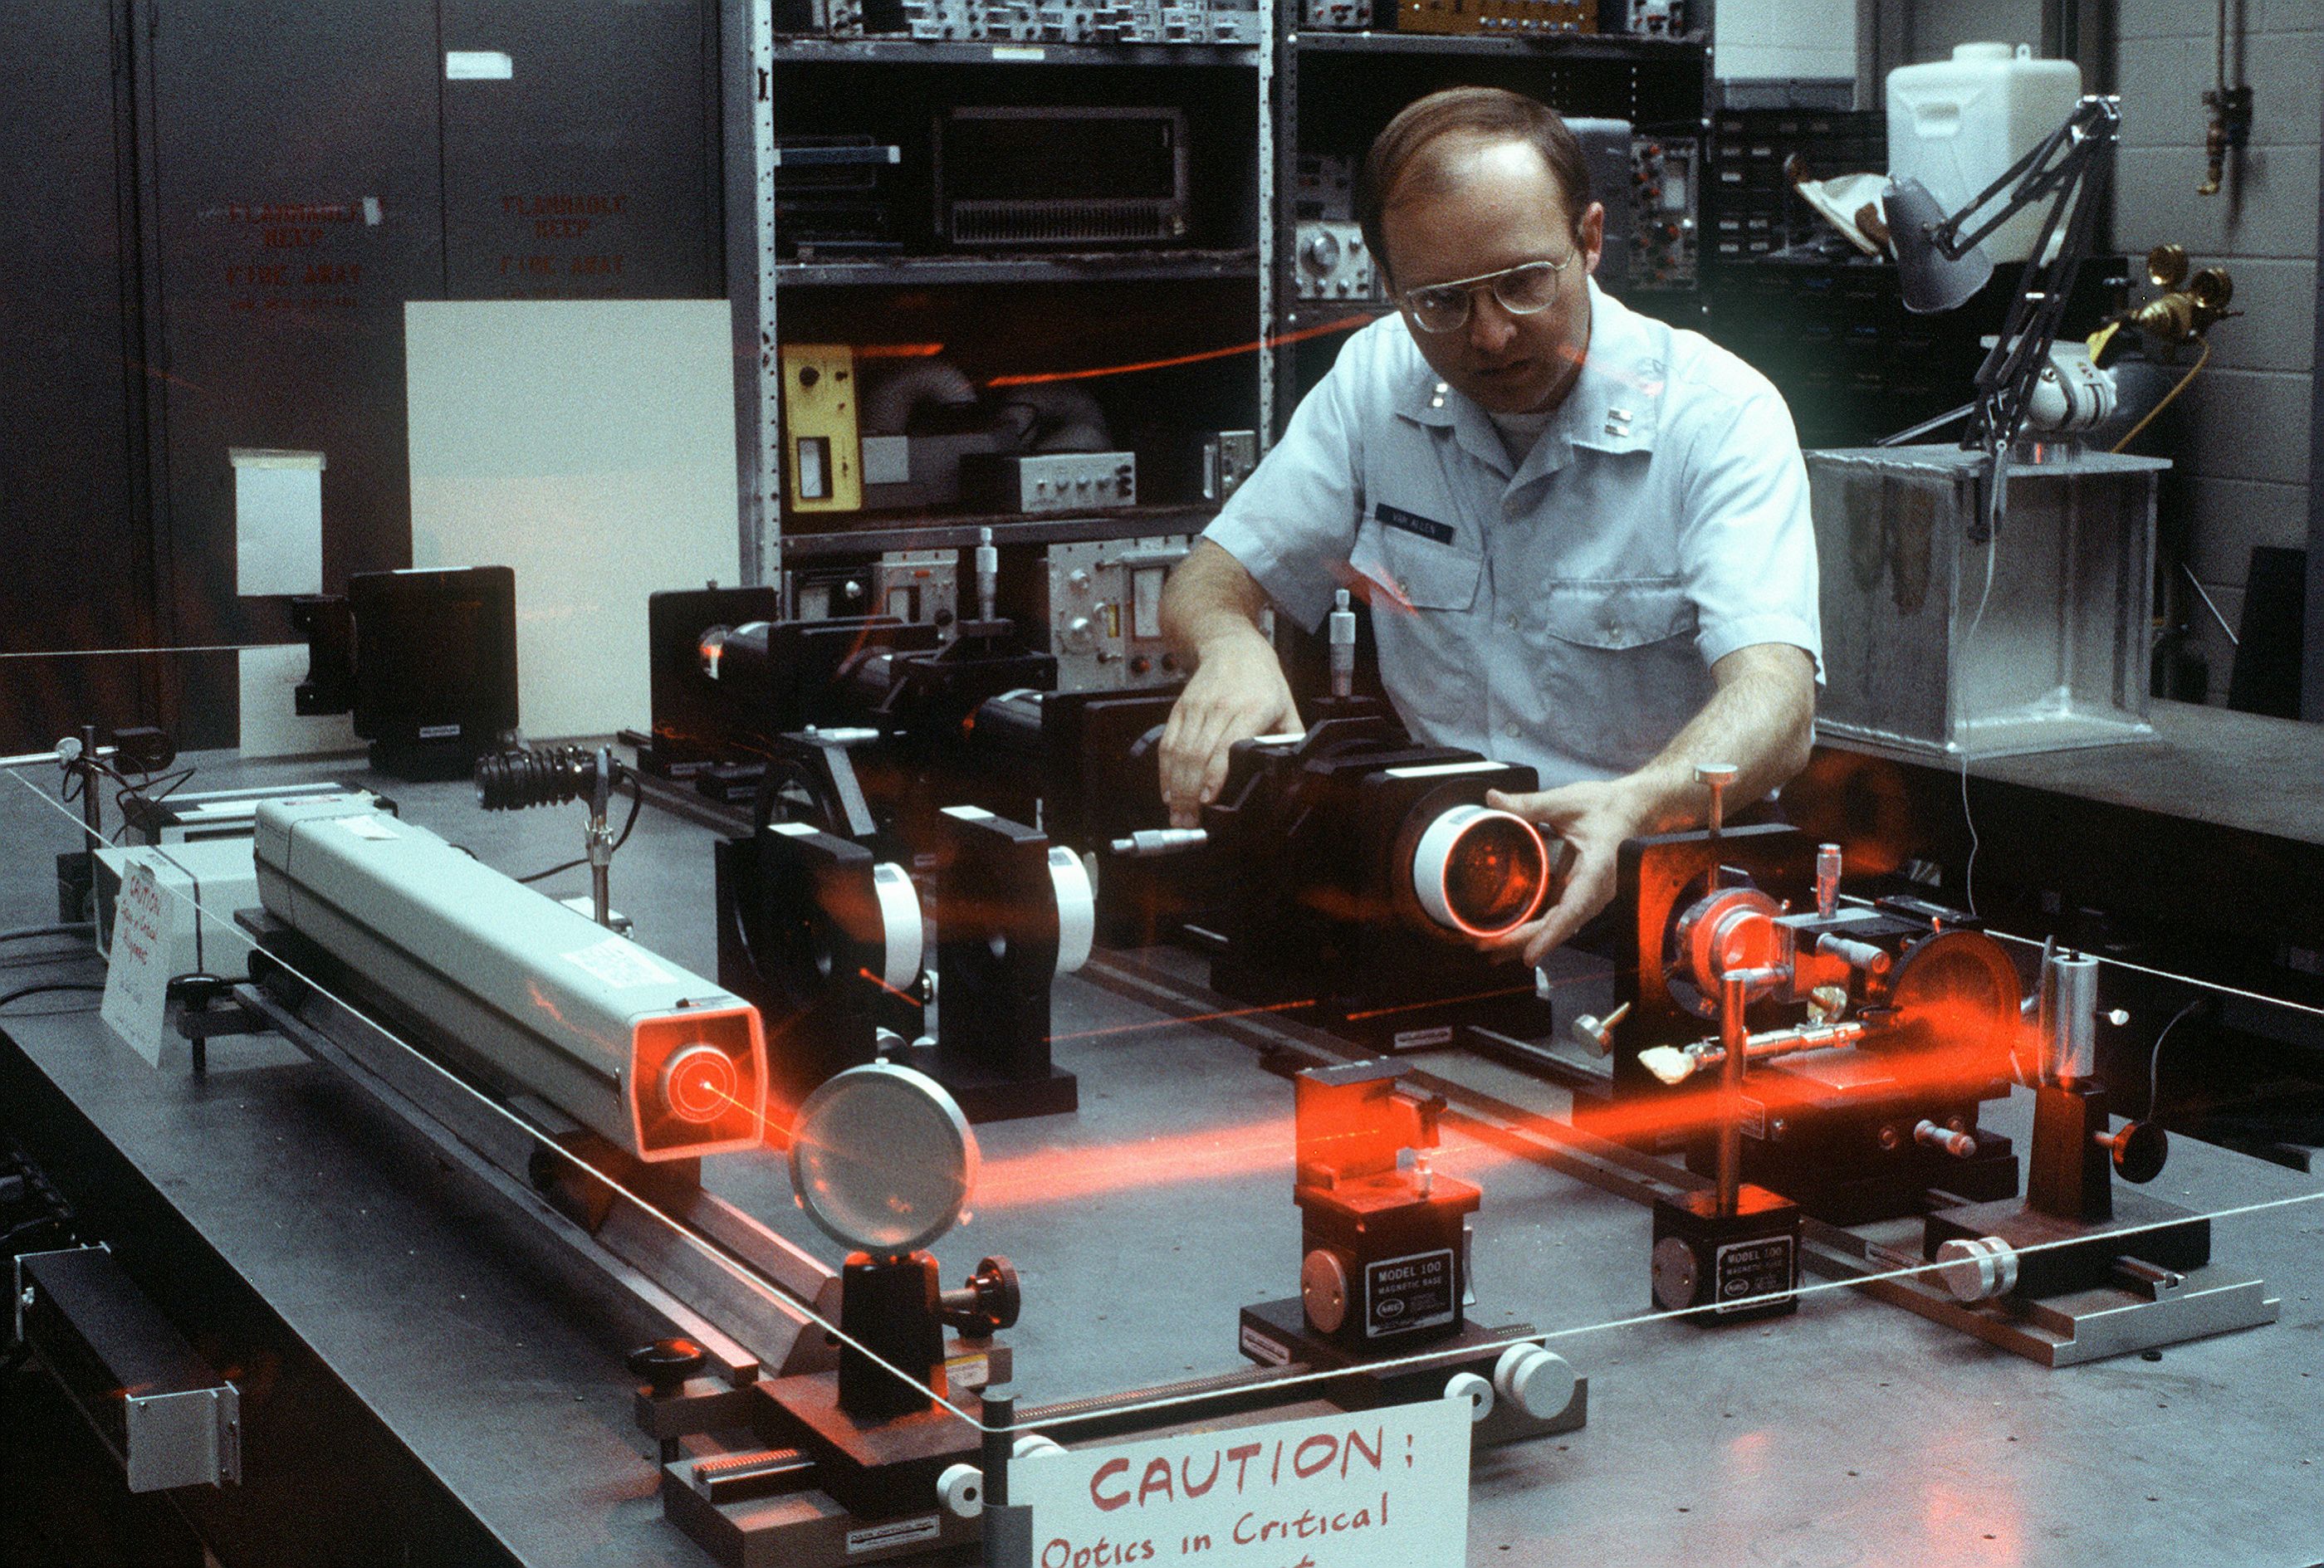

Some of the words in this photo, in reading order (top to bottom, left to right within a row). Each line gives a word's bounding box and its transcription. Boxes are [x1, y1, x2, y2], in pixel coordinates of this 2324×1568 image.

[1727, 1250, 1760, 1264] MODEL
[1378, 1266, 1416, 1283] MODEL
[1421, 1261, 1441, 1275] 100
[1377, 1280, 1420, 1295] MAGNETIC
[1421, 1276, 1442, 1287] BASE
[1041, 1536, 1155, 1568] Optics
[1182, 1534, 1212, 1556] in
[1232, 1491, 1388, 1546] Critical
